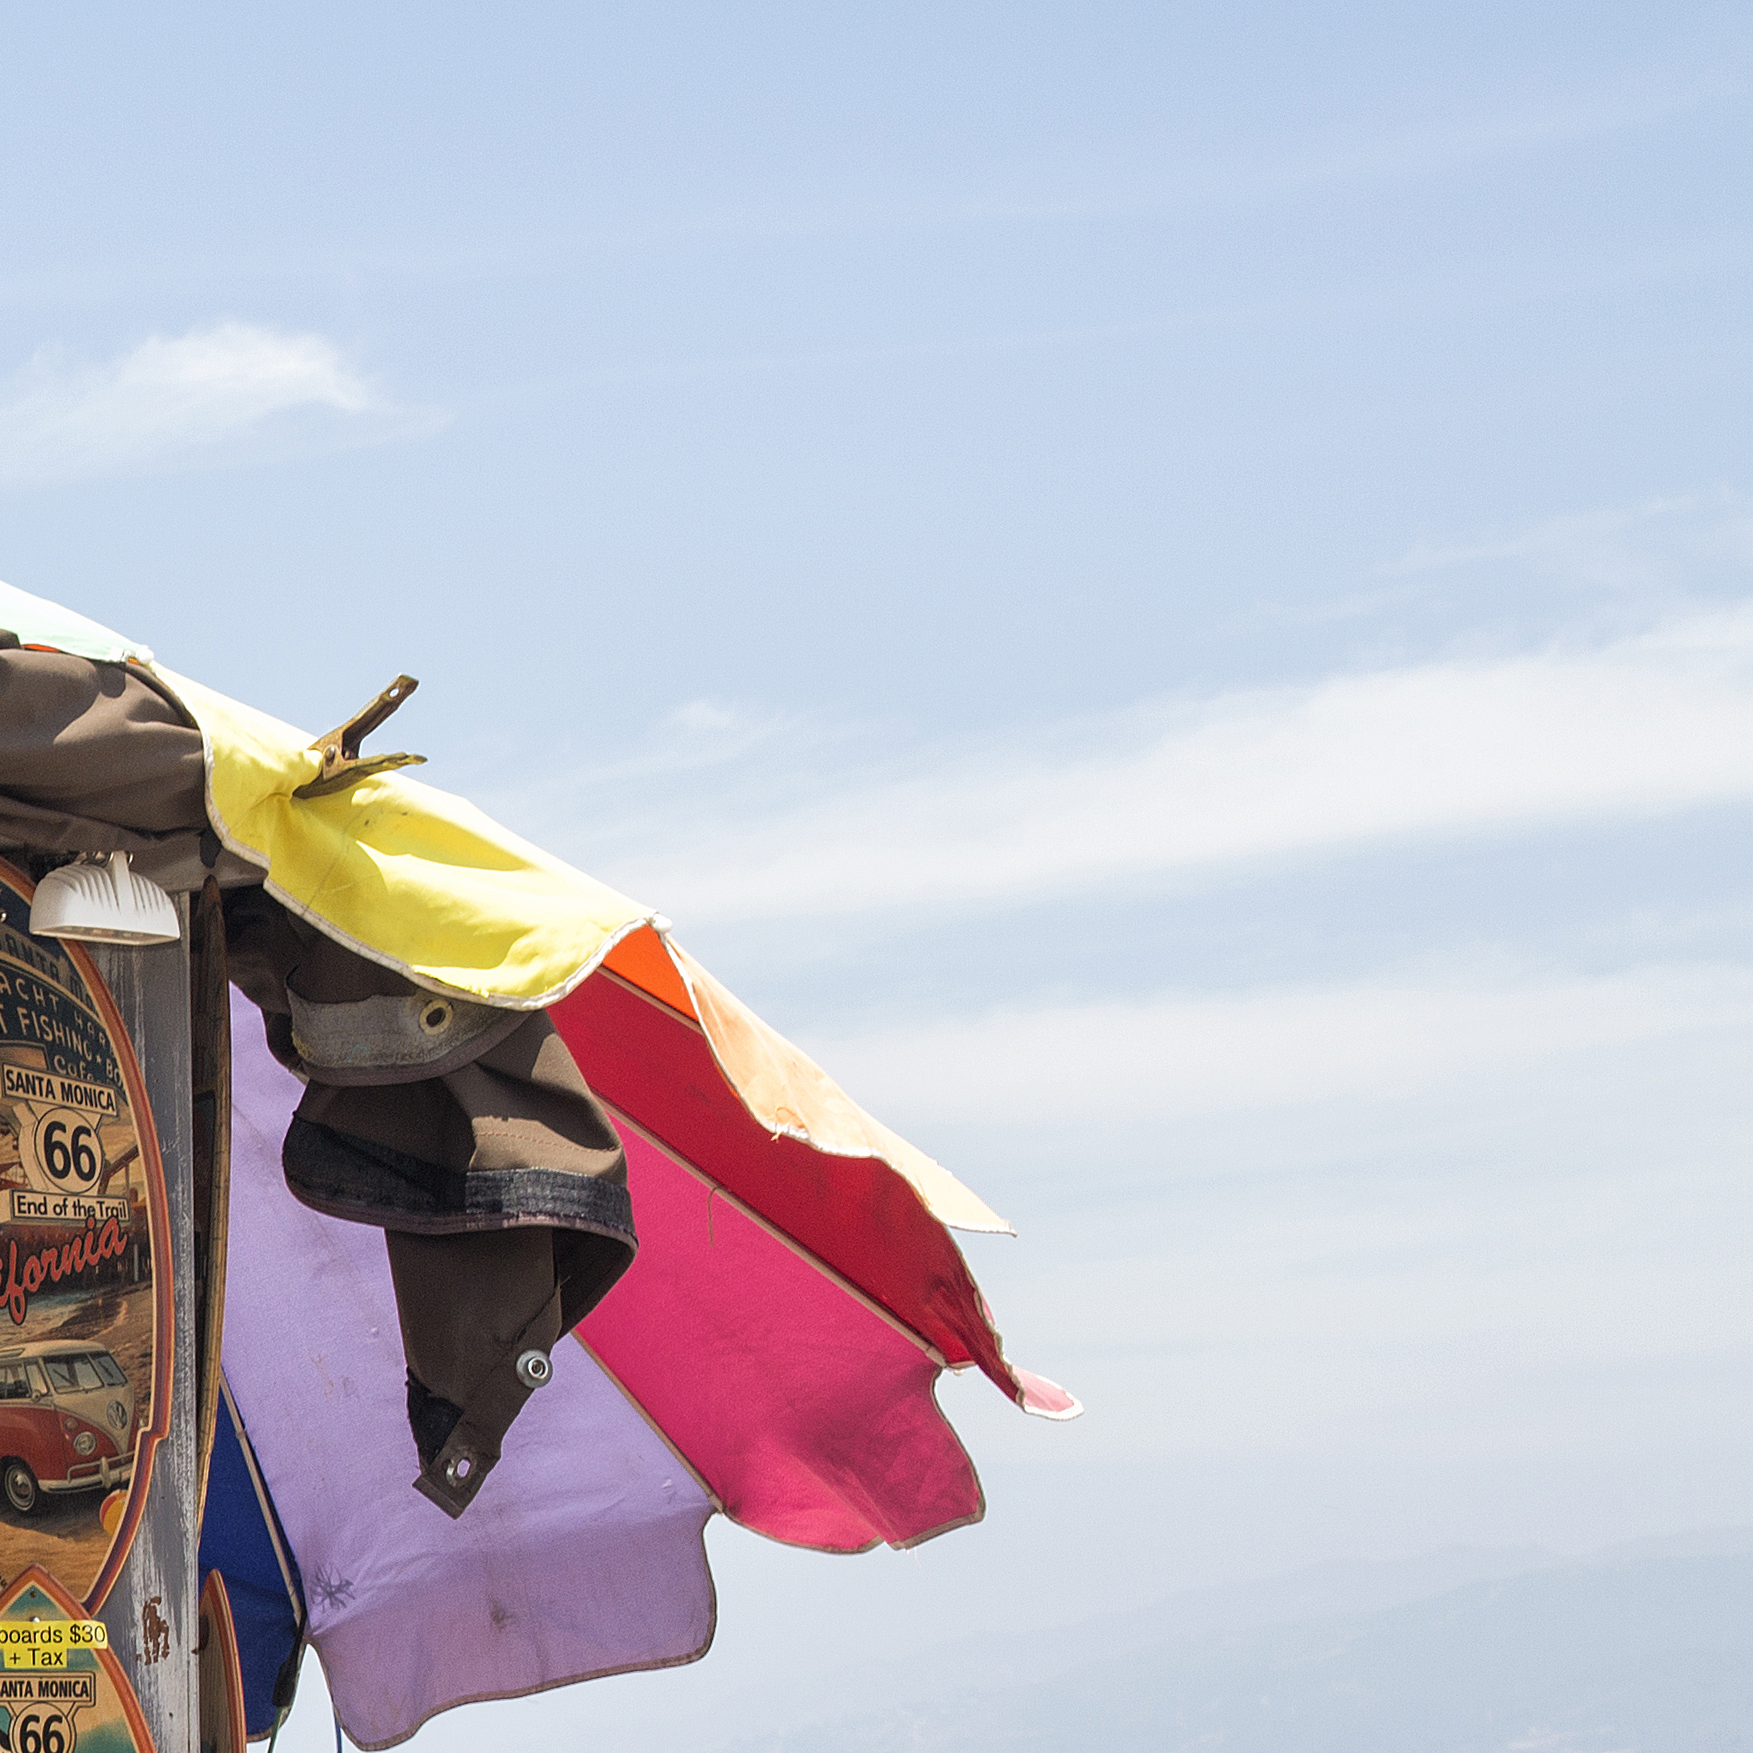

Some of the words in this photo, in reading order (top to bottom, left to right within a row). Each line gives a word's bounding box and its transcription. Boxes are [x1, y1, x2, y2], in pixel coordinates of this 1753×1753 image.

[16, 1005, 93, 1060] FISHING
[5, 1068, 56, 1101] SANTA
[59, 1081, 116, 1113] MONICA
[42, 1119, 96, 1183] 66
[16, 1195, 49, 1216] End
[69, 1623, 106, 1645] $30
[26, 1647, 65, 1667] Tax
[37, 1679, 90, 1699] MONICA
